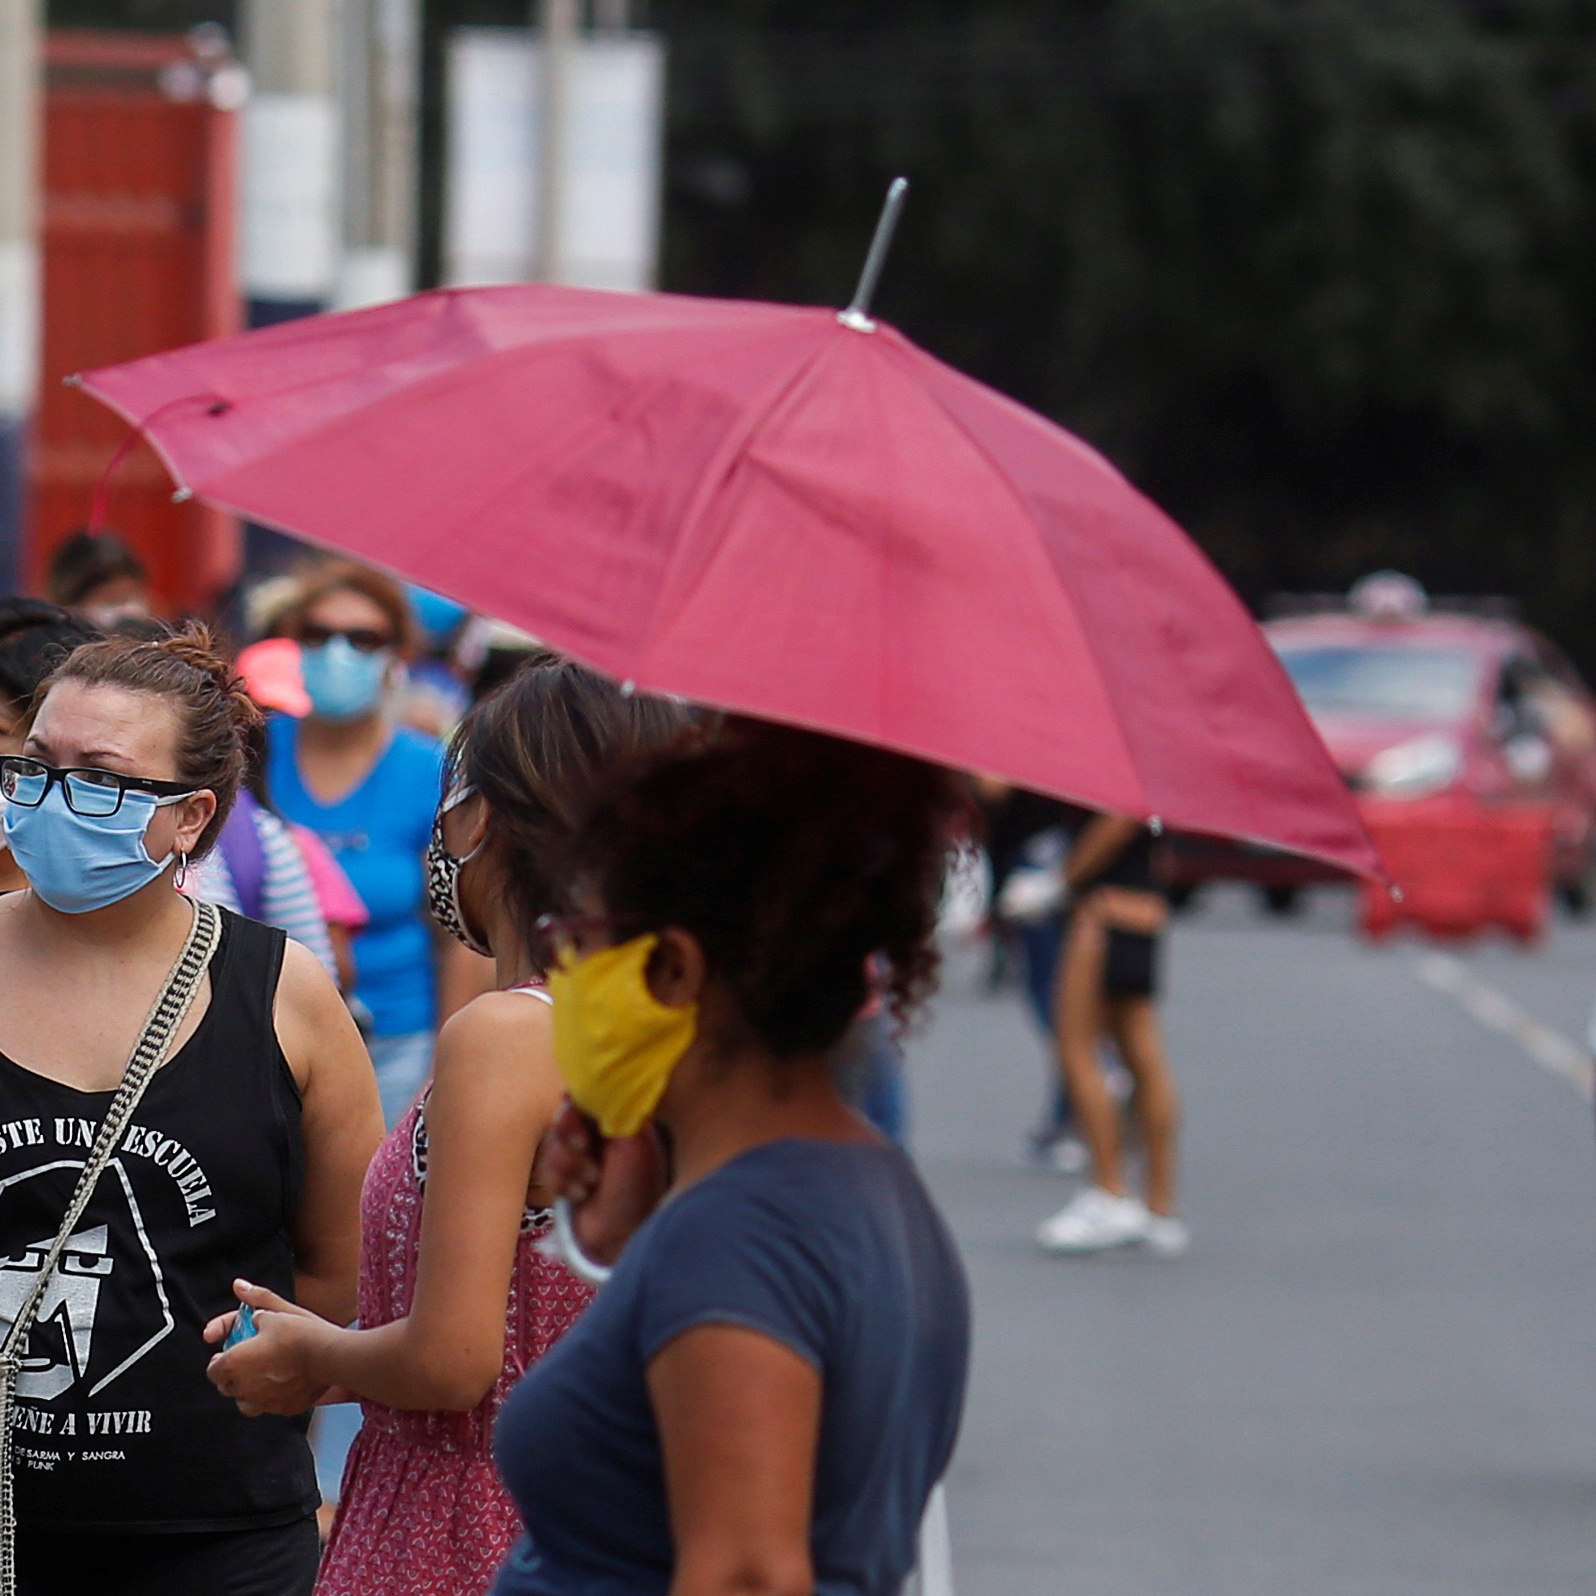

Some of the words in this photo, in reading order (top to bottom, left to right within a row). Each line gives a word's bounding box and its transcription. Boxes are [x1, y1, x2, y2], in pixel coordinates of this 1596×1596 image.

[120, 1124, 216, 1228] ESCUELA
[12, 1405, 55, 1435] EÑE
[59, 1412, 76, 1436] A
[86, 1410, 152, 1435] VIVIR
[27, 1459, 55, 1471] PUNK
[67, 1451, 76, 1460] Y
[81, 1450, 125, 1461] SANGRA
